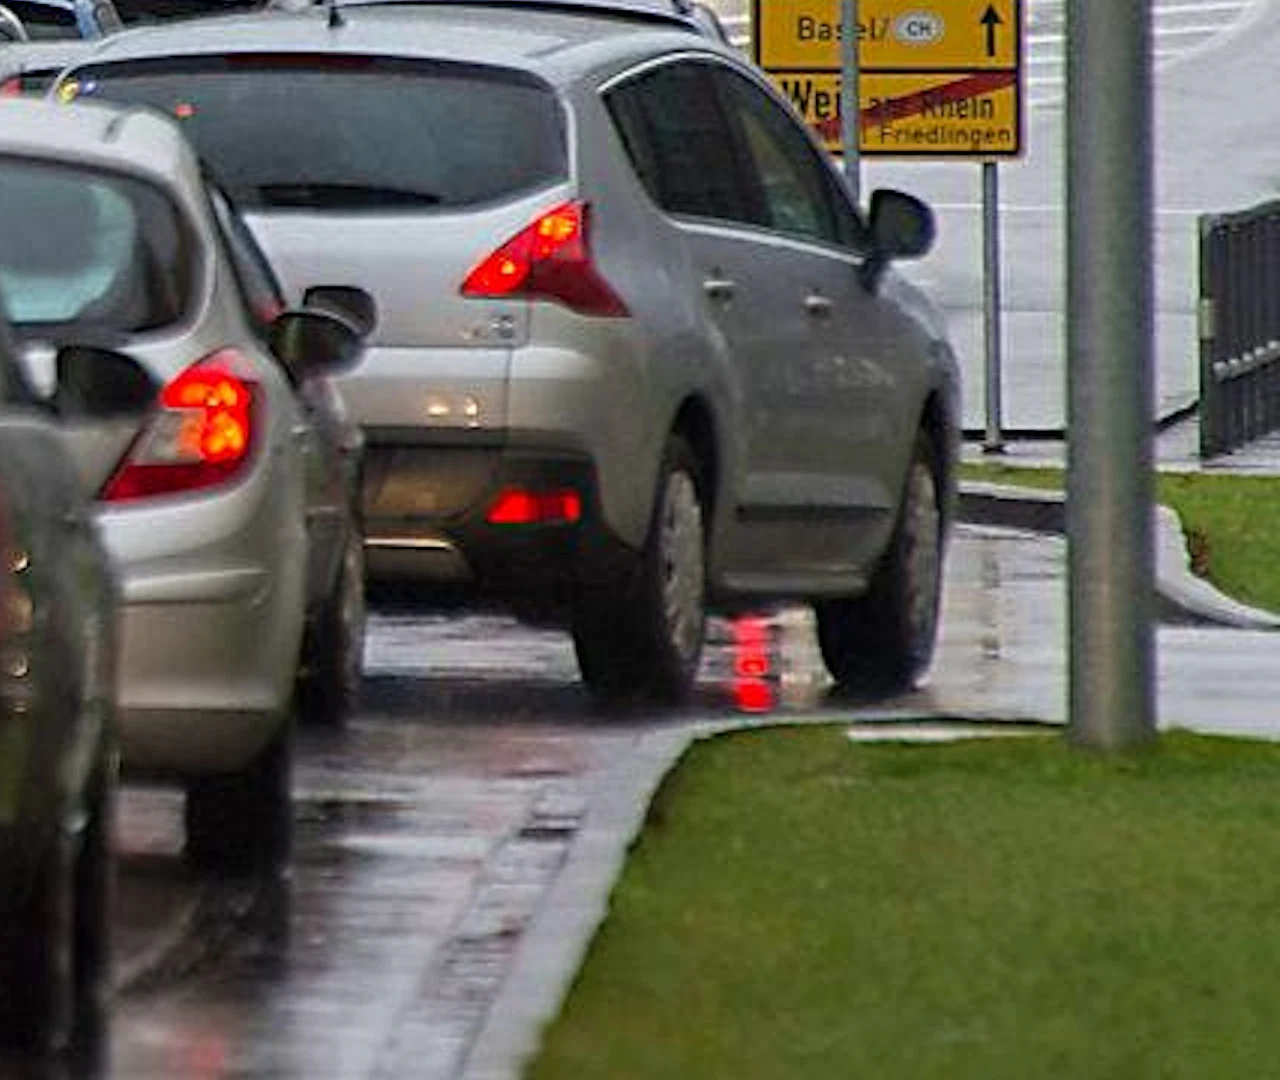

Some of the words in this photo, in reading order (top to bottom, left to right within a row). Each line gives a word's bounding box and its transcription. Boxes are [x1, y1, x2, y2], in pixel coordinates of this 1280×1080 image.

[906, 21, 932, 36] CH
[782, 80, 848, 118] Wei
[880, 122, 1011, 150] Friedlingen
